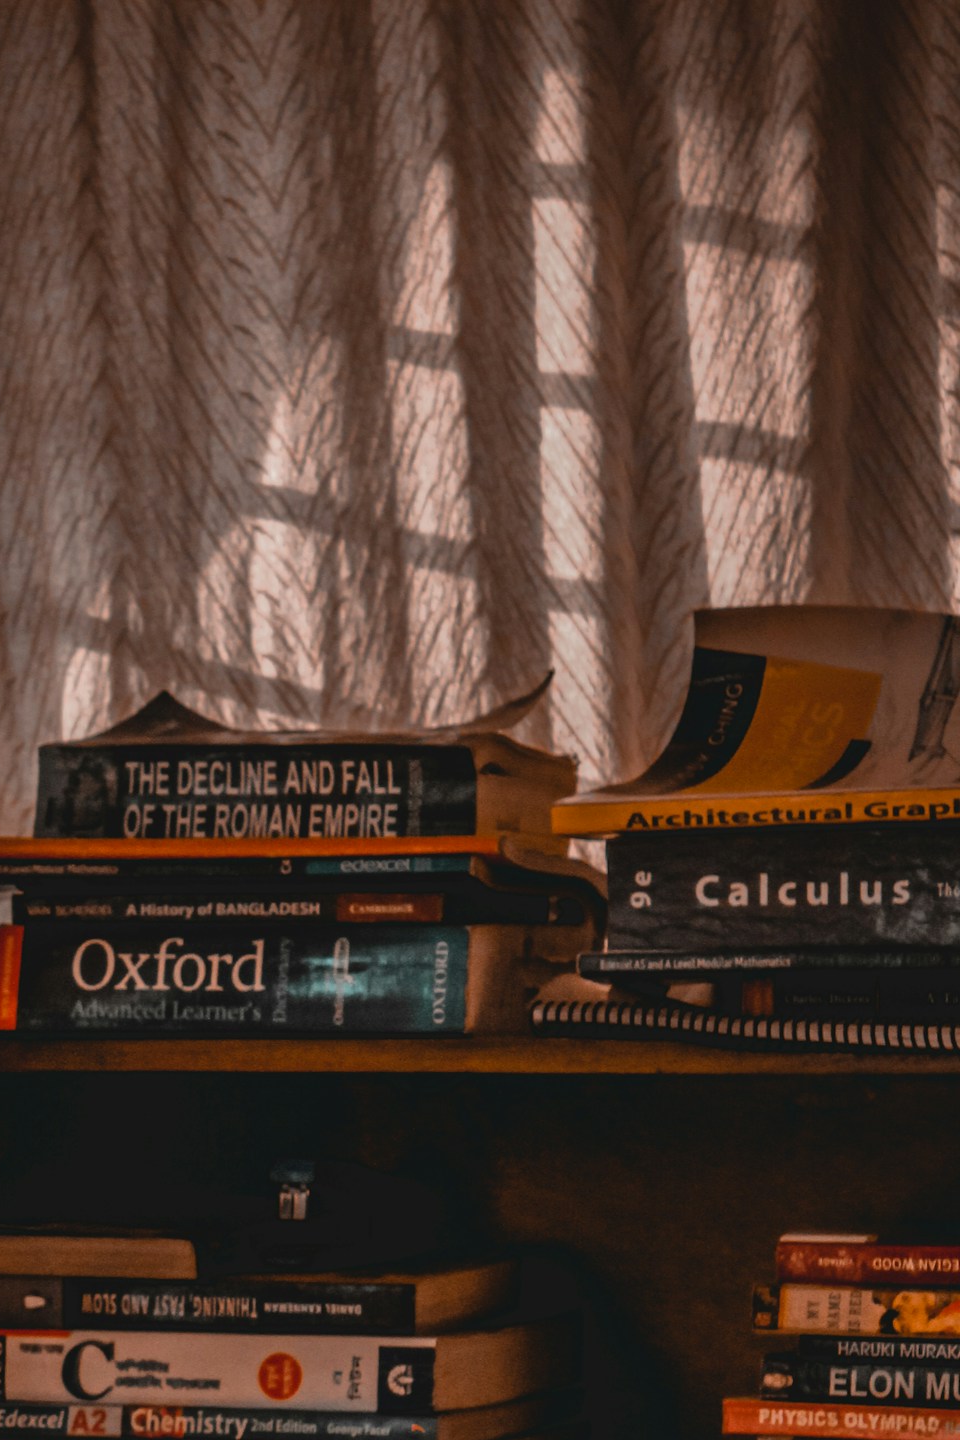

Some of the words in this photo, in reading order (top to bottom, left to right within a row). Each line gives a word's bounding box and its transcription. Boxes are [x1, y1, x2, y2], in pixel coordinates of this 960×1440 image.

[125, 761, 169, 795] THE
[177, 761, 277, 795] DECLINE
[284, 761, 334, 795] AND
[341, 760, 401, 795] FALL
[123, 804, 154, 837] OF
[162, 804, 207, 837] THE
[213, 804, 300, 837] ROMAN
[308, 804, 398, 837] EMPIRE
[626, 803, 852, 829] Architectural
[340, 858, 410, 872] edexcel
[695, 872, 911, 906] Calculus
[126, 903, 136, 915] A
[140, 902, 194, 919] History
[197, 901, 213, 916] of
[215, 902, 321, 917] BANGLADESH
[72, 937, 266, 994] Oxford
[431, 940, 449, 1025] OXFORD
[70, 999, 167, 1021] Advanced
[172, 1000, 261, 1022] Learner's
[872, 1257, 915, 1272] WOOD
[82, 1292, 117, 1315] SLOW
[122, 1293, 149, 1316] AND
[153, 1294, 186, 1317] FAST
[189, 1293, 258, 1319] THINKING,
[326, 1303, 362, 1316] DANIEL
[837, 1341, 894, 1357] HARUKI
[61, 1339, 115, 1400] C
[829, 1367, 915, 1399] ELON
[73, 1410, 107, 1433] A2
[130, 1410, 248, 1440] Chemistry
[251, 1417, 273, 1432] 2nd
[276, 1419, 317, 1434] Edition
[758, 1408, 838, 1427] PHYSICS
[844, 1411, 940, 1432] OLYMPIAD
